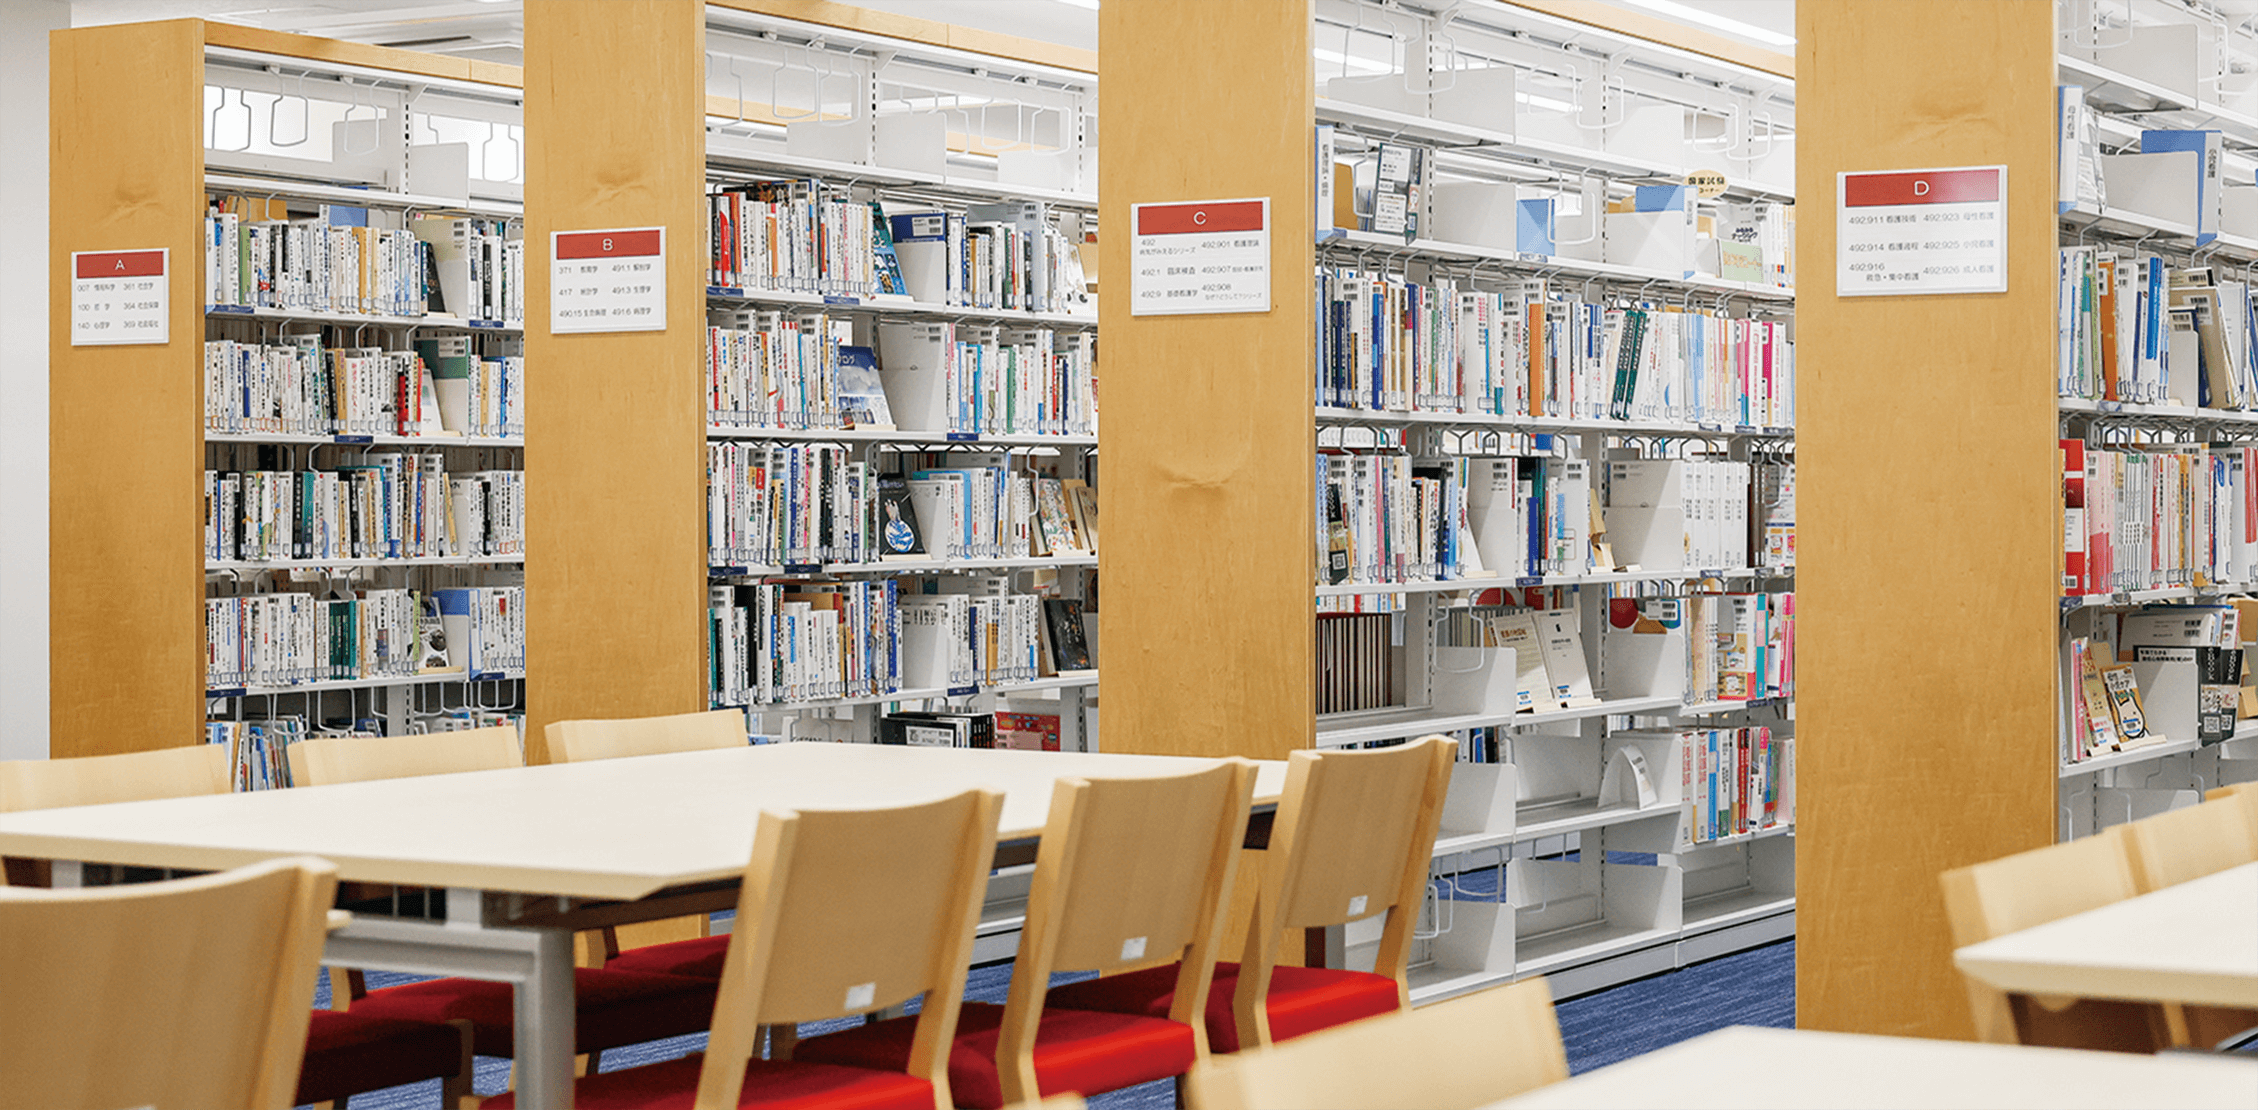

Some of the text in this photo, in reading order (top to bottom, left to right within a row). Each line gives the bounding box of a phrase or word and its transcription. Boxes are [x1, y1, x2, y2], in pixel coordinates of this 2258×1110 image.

[1914, 180, 1930, 196] D
[1193, 211, 1206, 225] C
[603, 238, 613, 251] B
[115, 259, 125, 270] A
